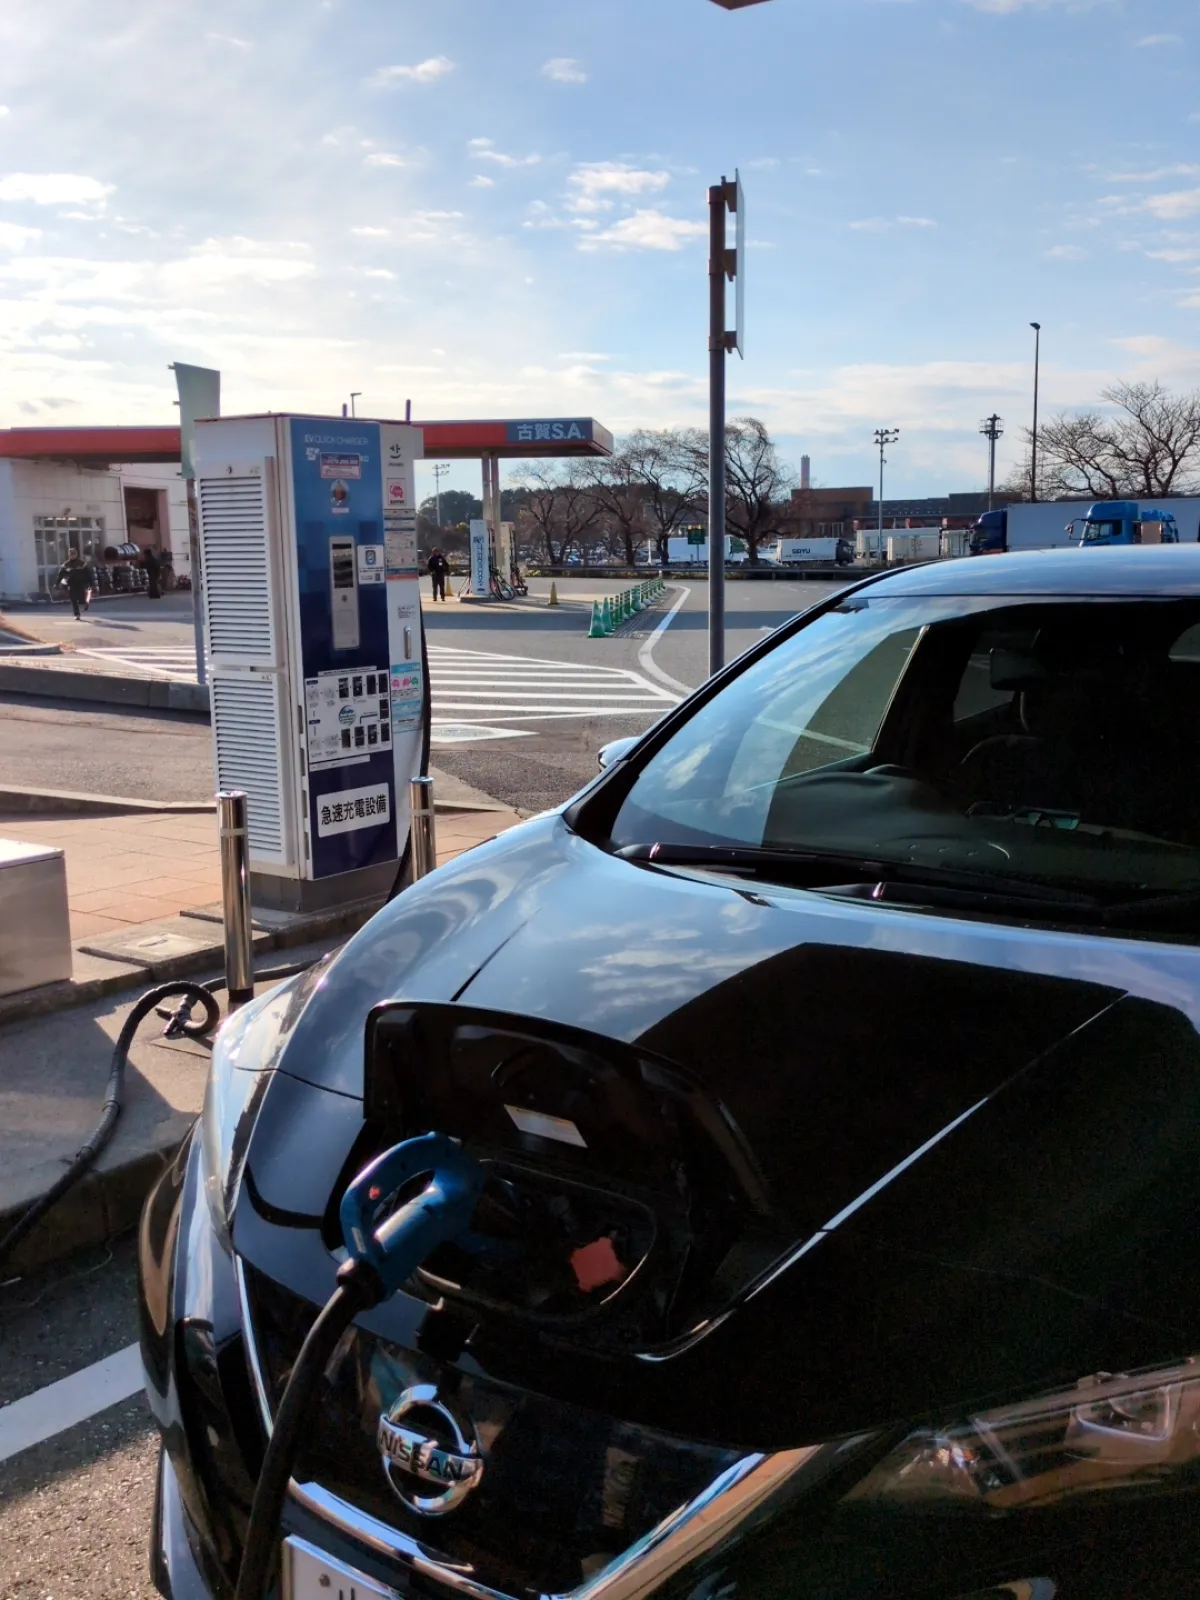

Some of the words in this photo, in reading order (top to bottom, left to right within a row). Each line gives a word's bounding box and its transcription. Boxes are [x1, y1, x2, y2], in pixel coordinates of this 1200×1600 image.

[304, 434, 314, 443] EV
[321, 794, 387, 825] 急速充電設備
[380, 1430, 463, 1480] NISSAN
